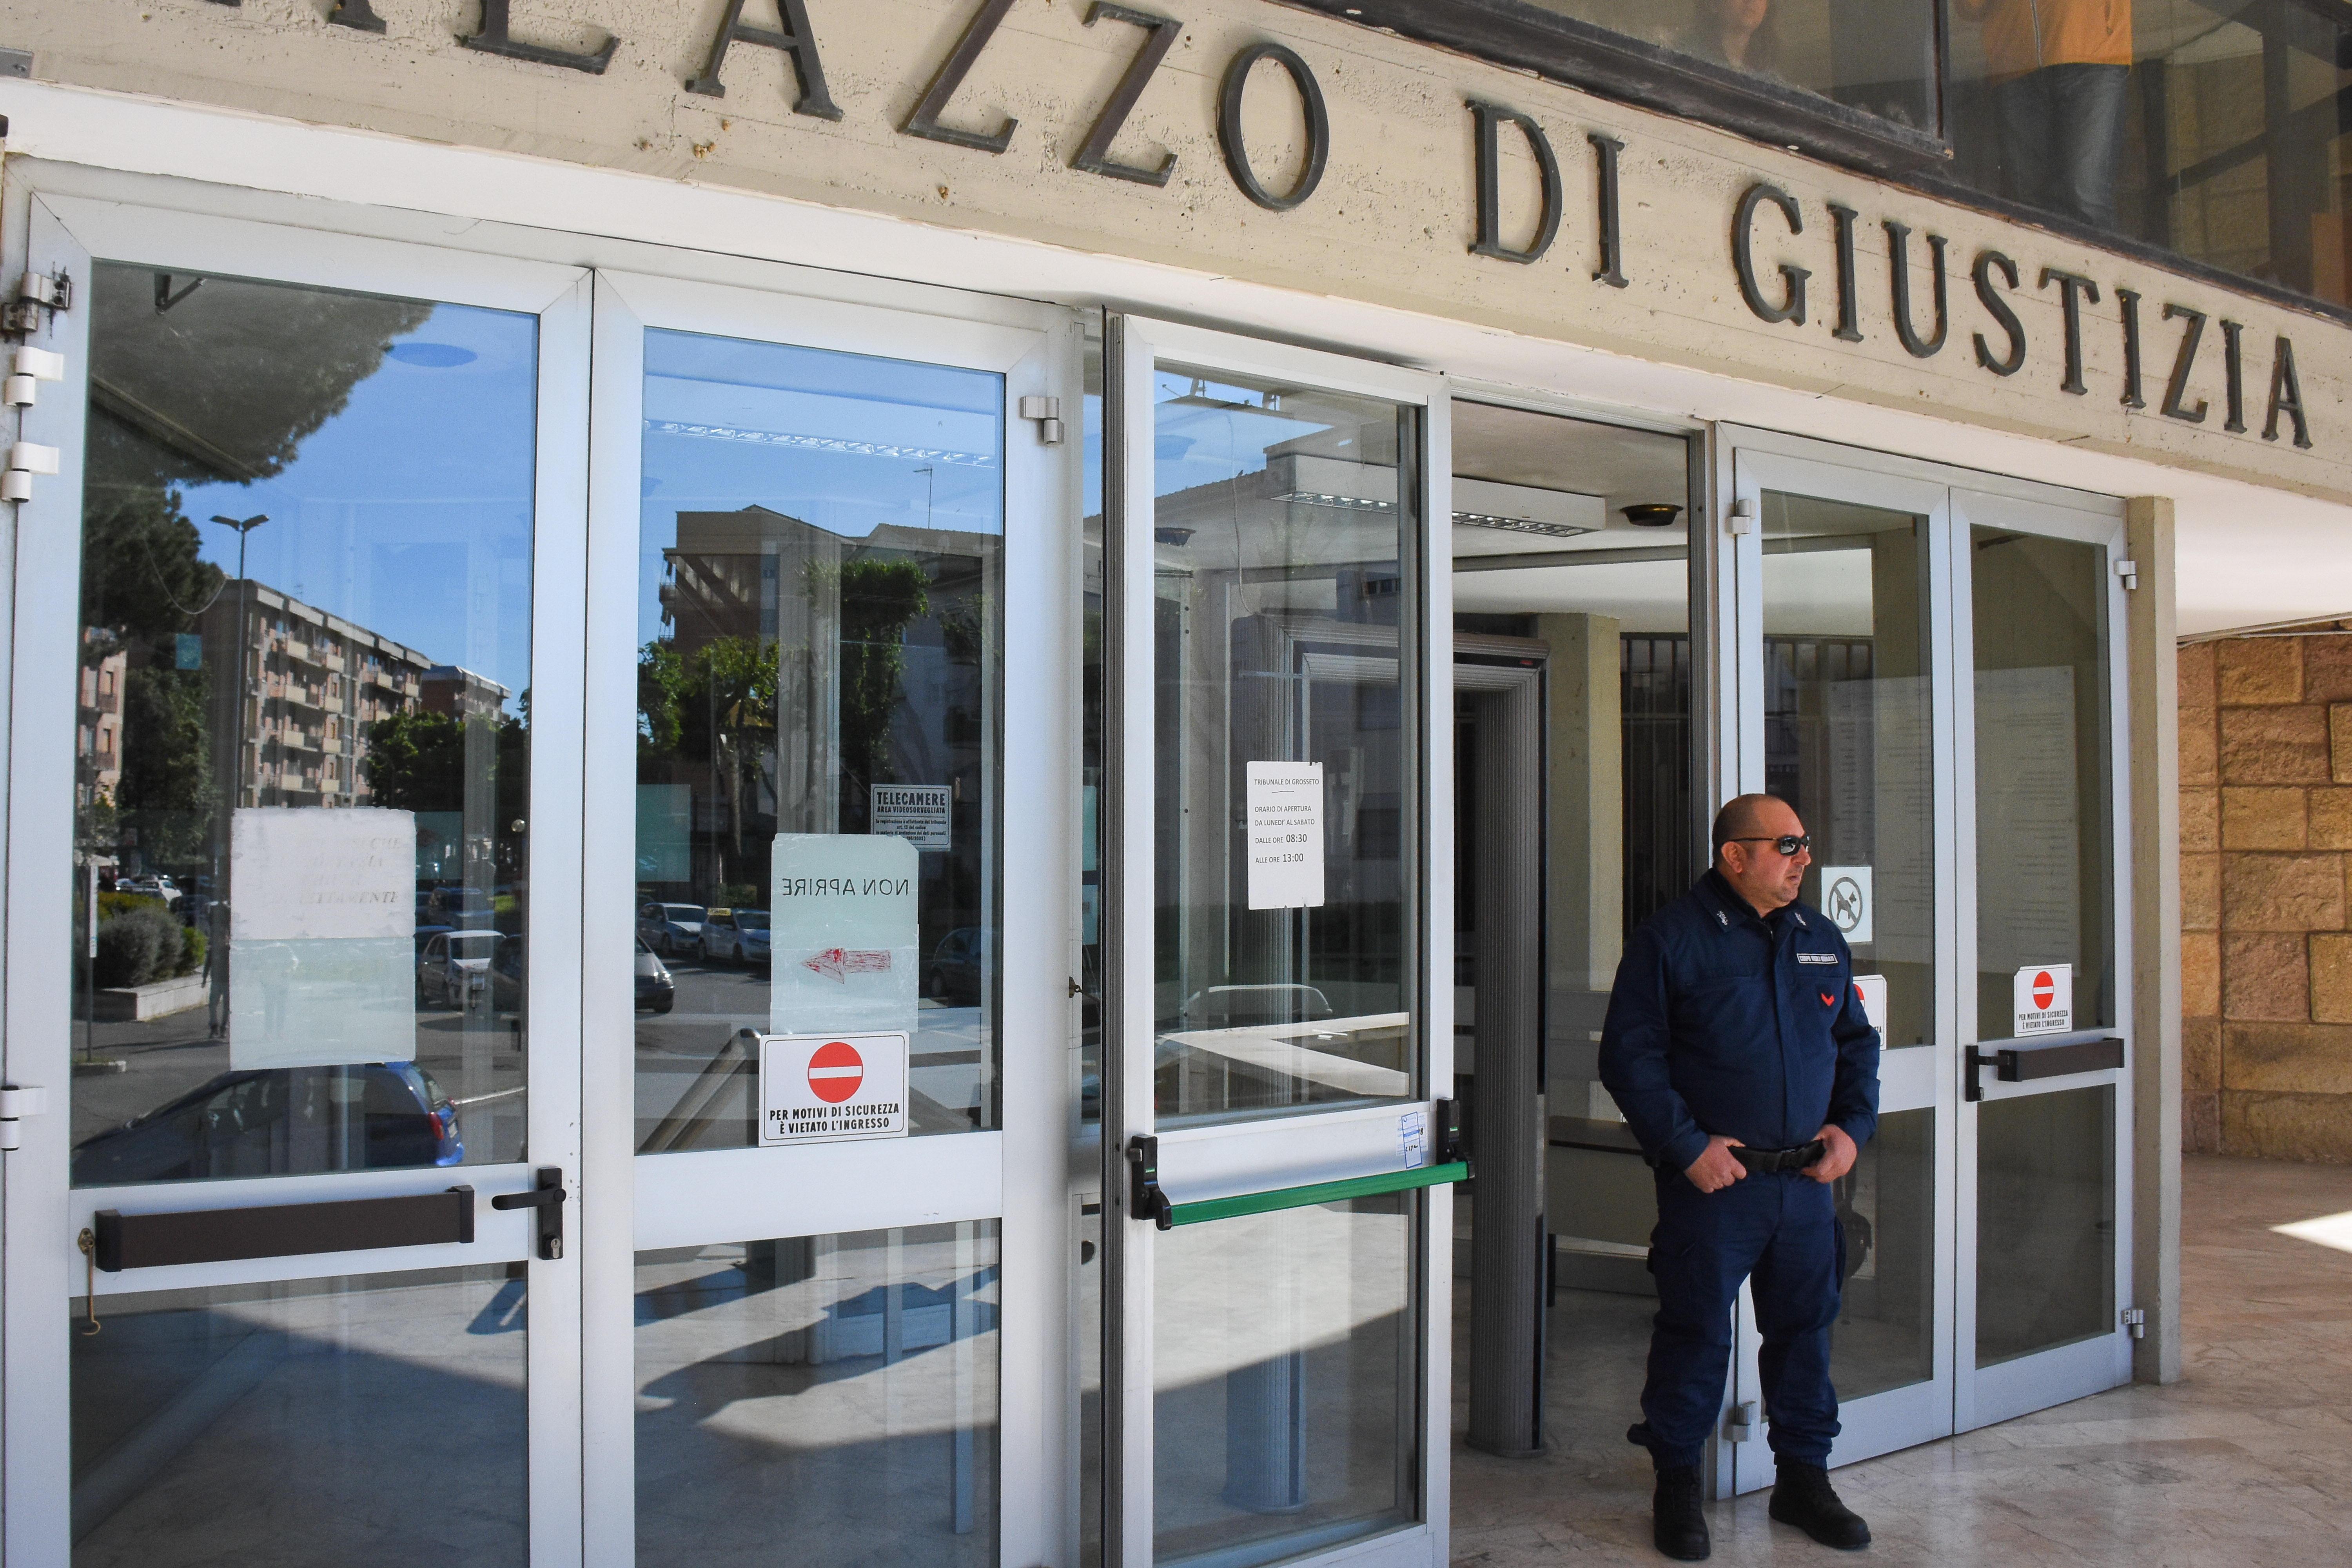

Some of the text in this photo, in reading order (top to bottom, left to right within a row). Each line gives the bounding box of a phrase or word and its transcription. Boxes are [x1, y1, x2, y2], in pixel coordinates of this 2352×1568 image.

[215, 0, 2314, 450] AZZO DI GIUSTIZIA
[877, 792, 945, 806] TELECAMERE
[1286, 834, 1307, 843] 08:30
[1283, 853, 1304, 862] 13:00
[769, 1103, 899, 1120] PER MOTIVI DI SICUREZZA
[780, 1117, 889, 1134] È VIETATO L'INGRESSO
